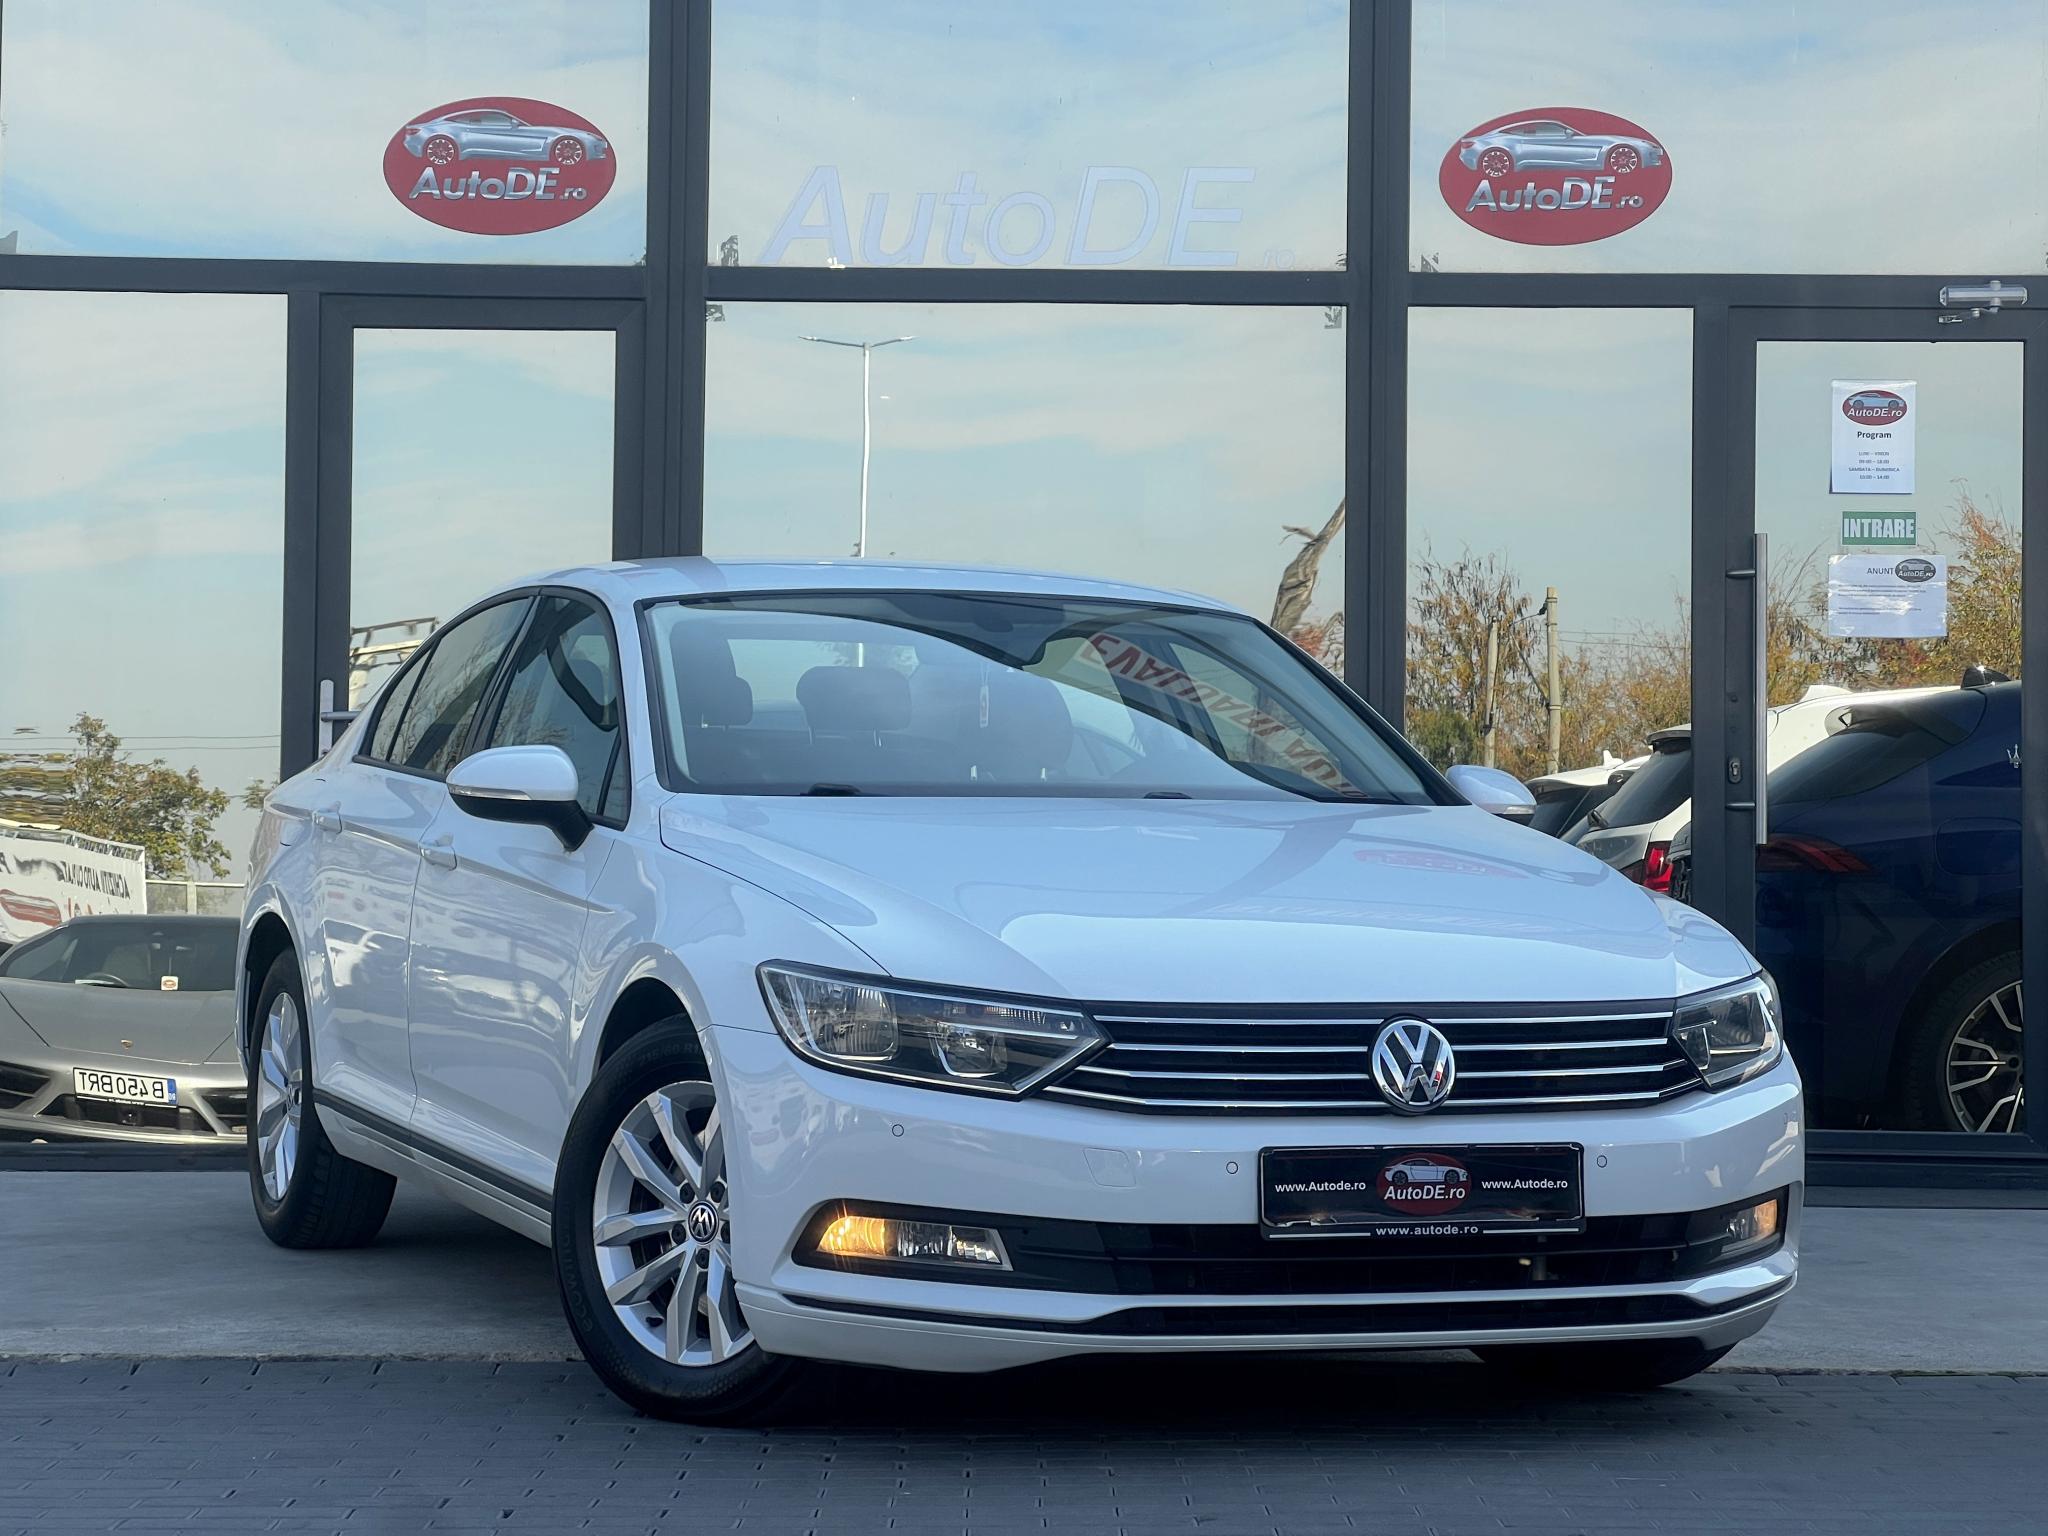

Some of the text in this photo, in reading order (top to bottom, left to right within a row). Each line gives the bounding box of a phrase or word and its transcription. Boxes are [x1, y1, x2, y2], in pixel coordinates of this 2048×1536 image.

[1847, 407, 1903, 417] AutoDE.ro
[1857, 431, 1892, 440] Program
[1843, 518, 1915, 538] INTRARE
[1274, 1180, 1367, 1193] www.Autode.ro
[1481, 1177, 1569, 1190] www.Autode.ro
[1384, 1184, 1466, 1201] AutoDE.ro
[1376, 1224, 1479, 1237] www.autode.ro
